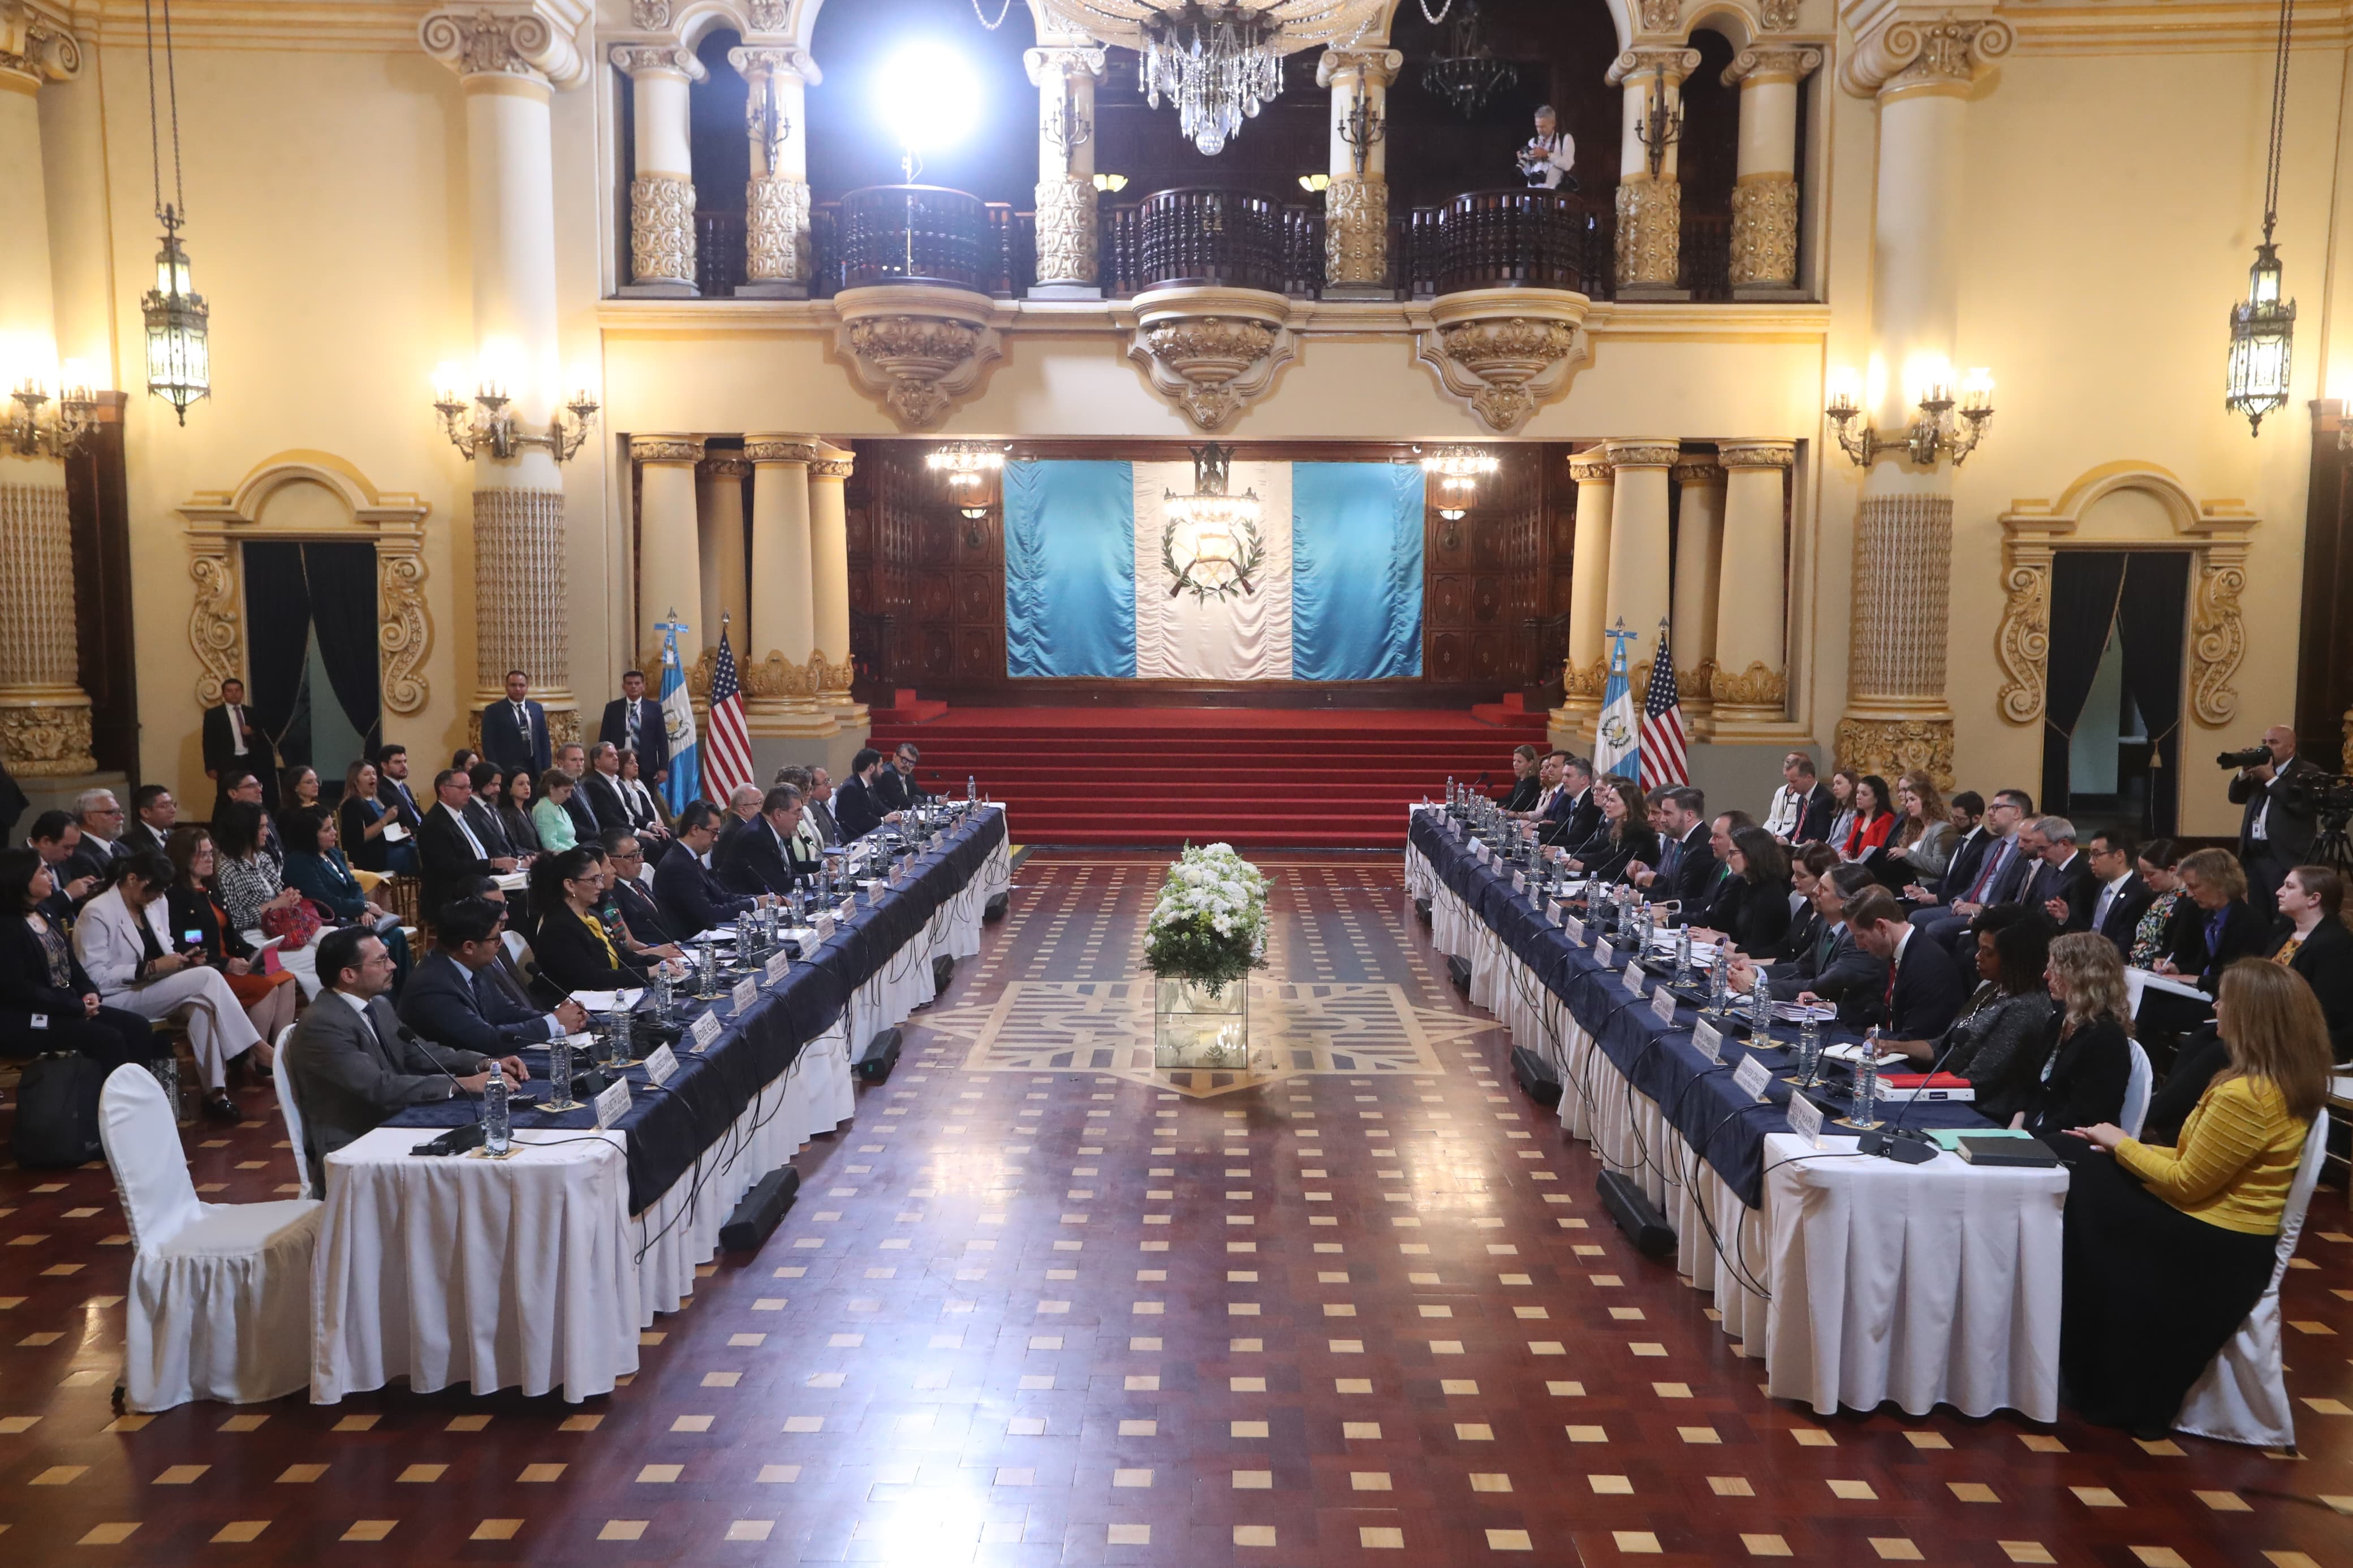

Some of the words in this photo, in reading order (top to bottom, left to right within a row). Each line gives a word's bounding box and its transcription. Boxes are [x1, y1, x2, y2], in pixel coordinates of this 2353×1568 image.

[696, 1026, 708, 1040] EDIE
[706, 1017, 718, 1031] CUX
[1791, 1103, 1802, 1118] KELLY
[1802, 1112, 1816, 1131] HAPKA
